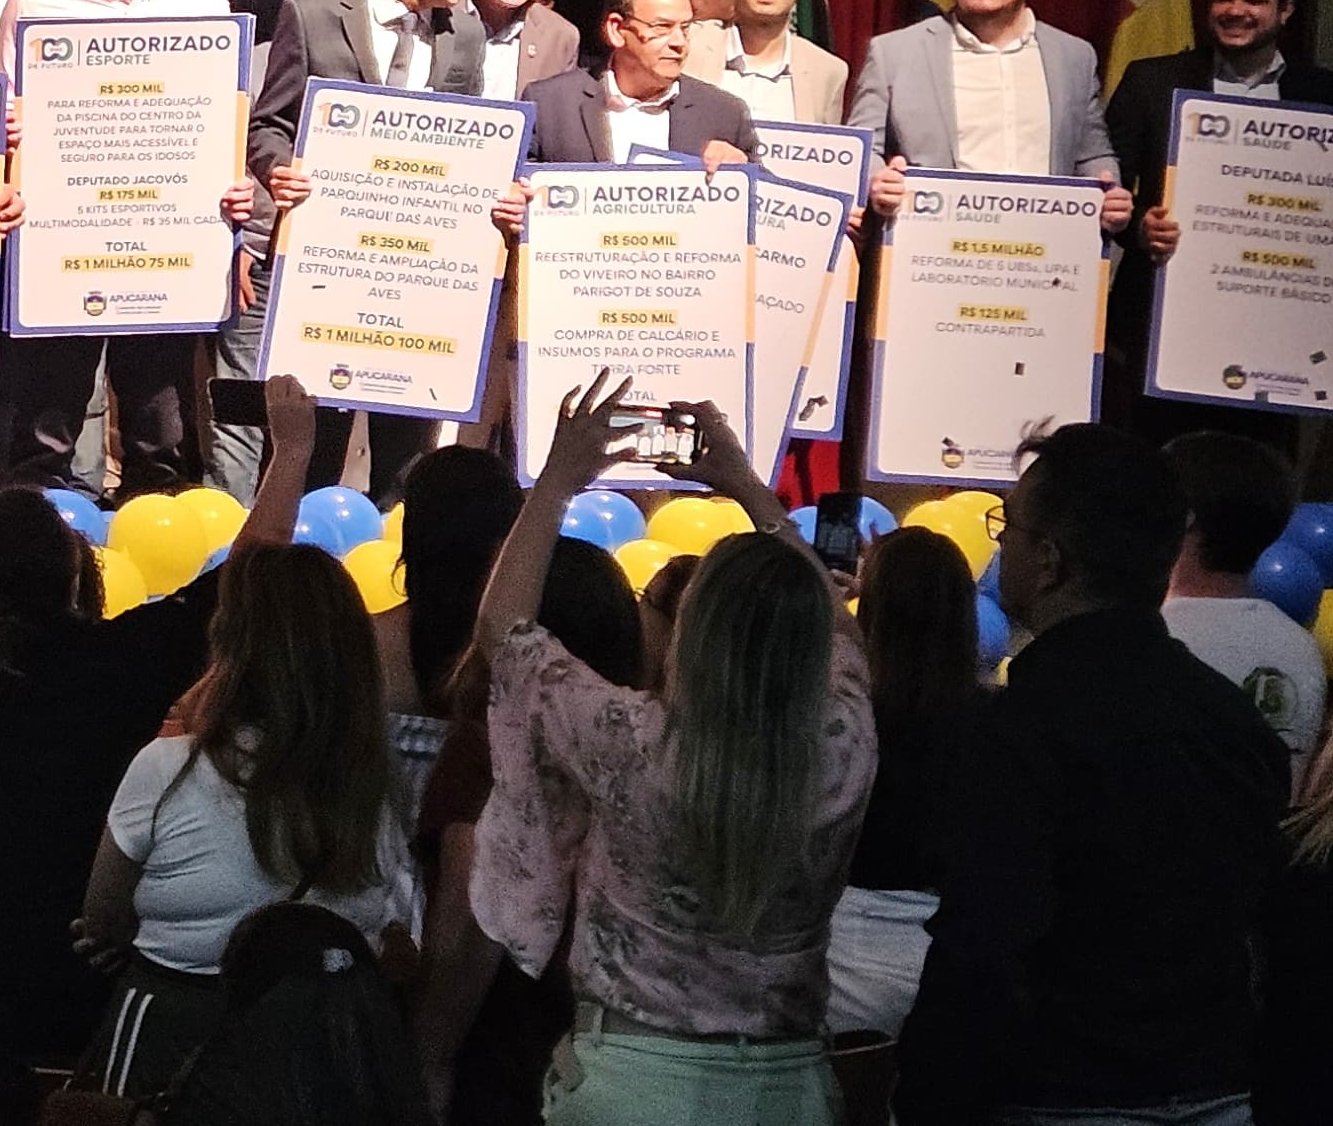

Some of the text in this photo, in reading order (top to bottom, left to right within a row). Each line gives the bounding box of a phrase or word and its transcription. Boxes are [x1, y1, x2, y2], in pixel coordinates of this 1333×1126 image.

[85, 34, 231, 54] AUTORIZADO
[85, 53, 151, 67] ESPORTE
[100, 83, 164, 95] R$ 300 MIL
[47, 99, 77, 109] PARA
[78, 98, 132, 109] REFORMA
[141, 95, 212, 108] ADEQUAÇÃO
[372, 109, 515, 140] AUTORIZADO
[369, 126, 486, 150] MEIO AMBIENTE
[754, 141, 856, 167] ORIZADO
[373, 158, 446, 177] R$ 200 MIL
[67, 172, 189, 187] DEPUTADO JACOVÓS
[310, 168, 385, 187] AQUISIÇÃO
[397, 179, 480, 198] INSTALAÇÃO
[481, 188, 500, 202] DE
[99, 189, 158, 201] R$ 175 MIL
[319, 186, 484, 215] PARQUINHO INFANTIL NO
[592, 184, 741, 203] AUTORIZADO
[592, 203, 696, 215] AGRICULTURA
[755, 196, 832, 227] RIZADO
[956, 194, 1097, 218] AUTORIZADO
[104, 241, 148, 253] TOTAL
[360, 234, 431, 253] R$ 350 MIL
[603, 234, 677, 246] R$ 500 MIL
[64, 259, 81, 271] R$
[92, 255, 147, 269] MILHÃO
[148, 257, 165, 269] 75
[167, 256, 192, 268] MIL
[302, 245, 367, 262] REFORMA
[378, 254, 458, 273] AMPLIAÇÃO
[460, 262, 479, 275] DA
[674, 252, 742, 264] REFORMA
[559, 268, 717, 281] DO VIVEIRO NO BAIRRO
[108, 292, 168, 303] APUCARANA
[573, 285, 702, 299] PARIGOT DE SOUZA
[356, 312, 404, 329] TOTAL
[303, 326, 322, 341] R$
[335, 329, 396, 347] MILHÃO
[427, 339, 454, 354] MIL
[538, 346, 601, 358] INSUMOS
[604, 346, 640, 358] PARA
[656, 346, 736, 359] PROGRAMA
[622, 389, 656, 402] OTAL
